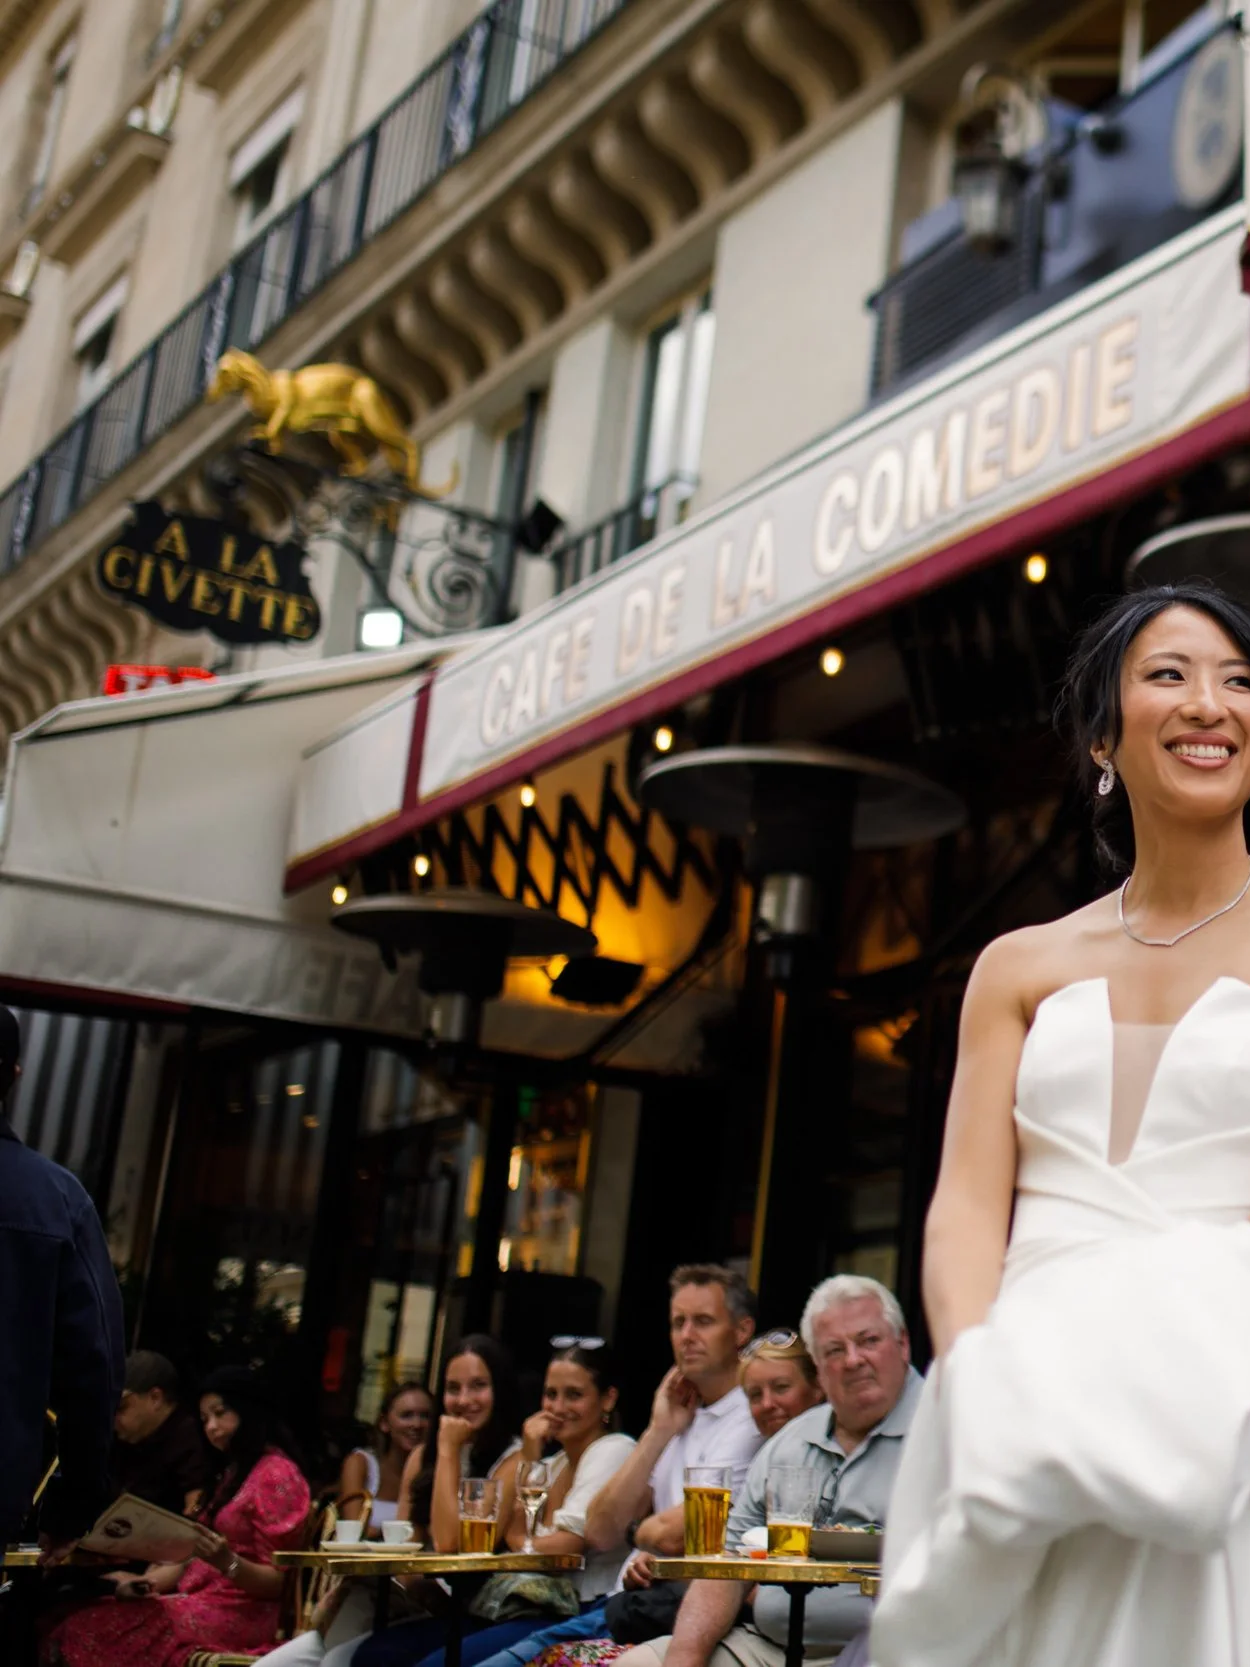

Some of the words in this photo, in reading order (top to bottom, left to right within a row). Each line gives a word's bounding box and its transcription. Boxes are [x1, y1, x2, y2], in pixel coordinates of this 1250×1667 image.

[154, 519, 189, 563] A
[219, 535, 278, 586] LA
[479, 613, 596, 748] CAFE
[615, 562, 688, 678] DE
[708, 517, 776, 631] LA
[810, 313, 1141, 577] COMEDIE
[103, 545, 314, 640] CIVETTE
